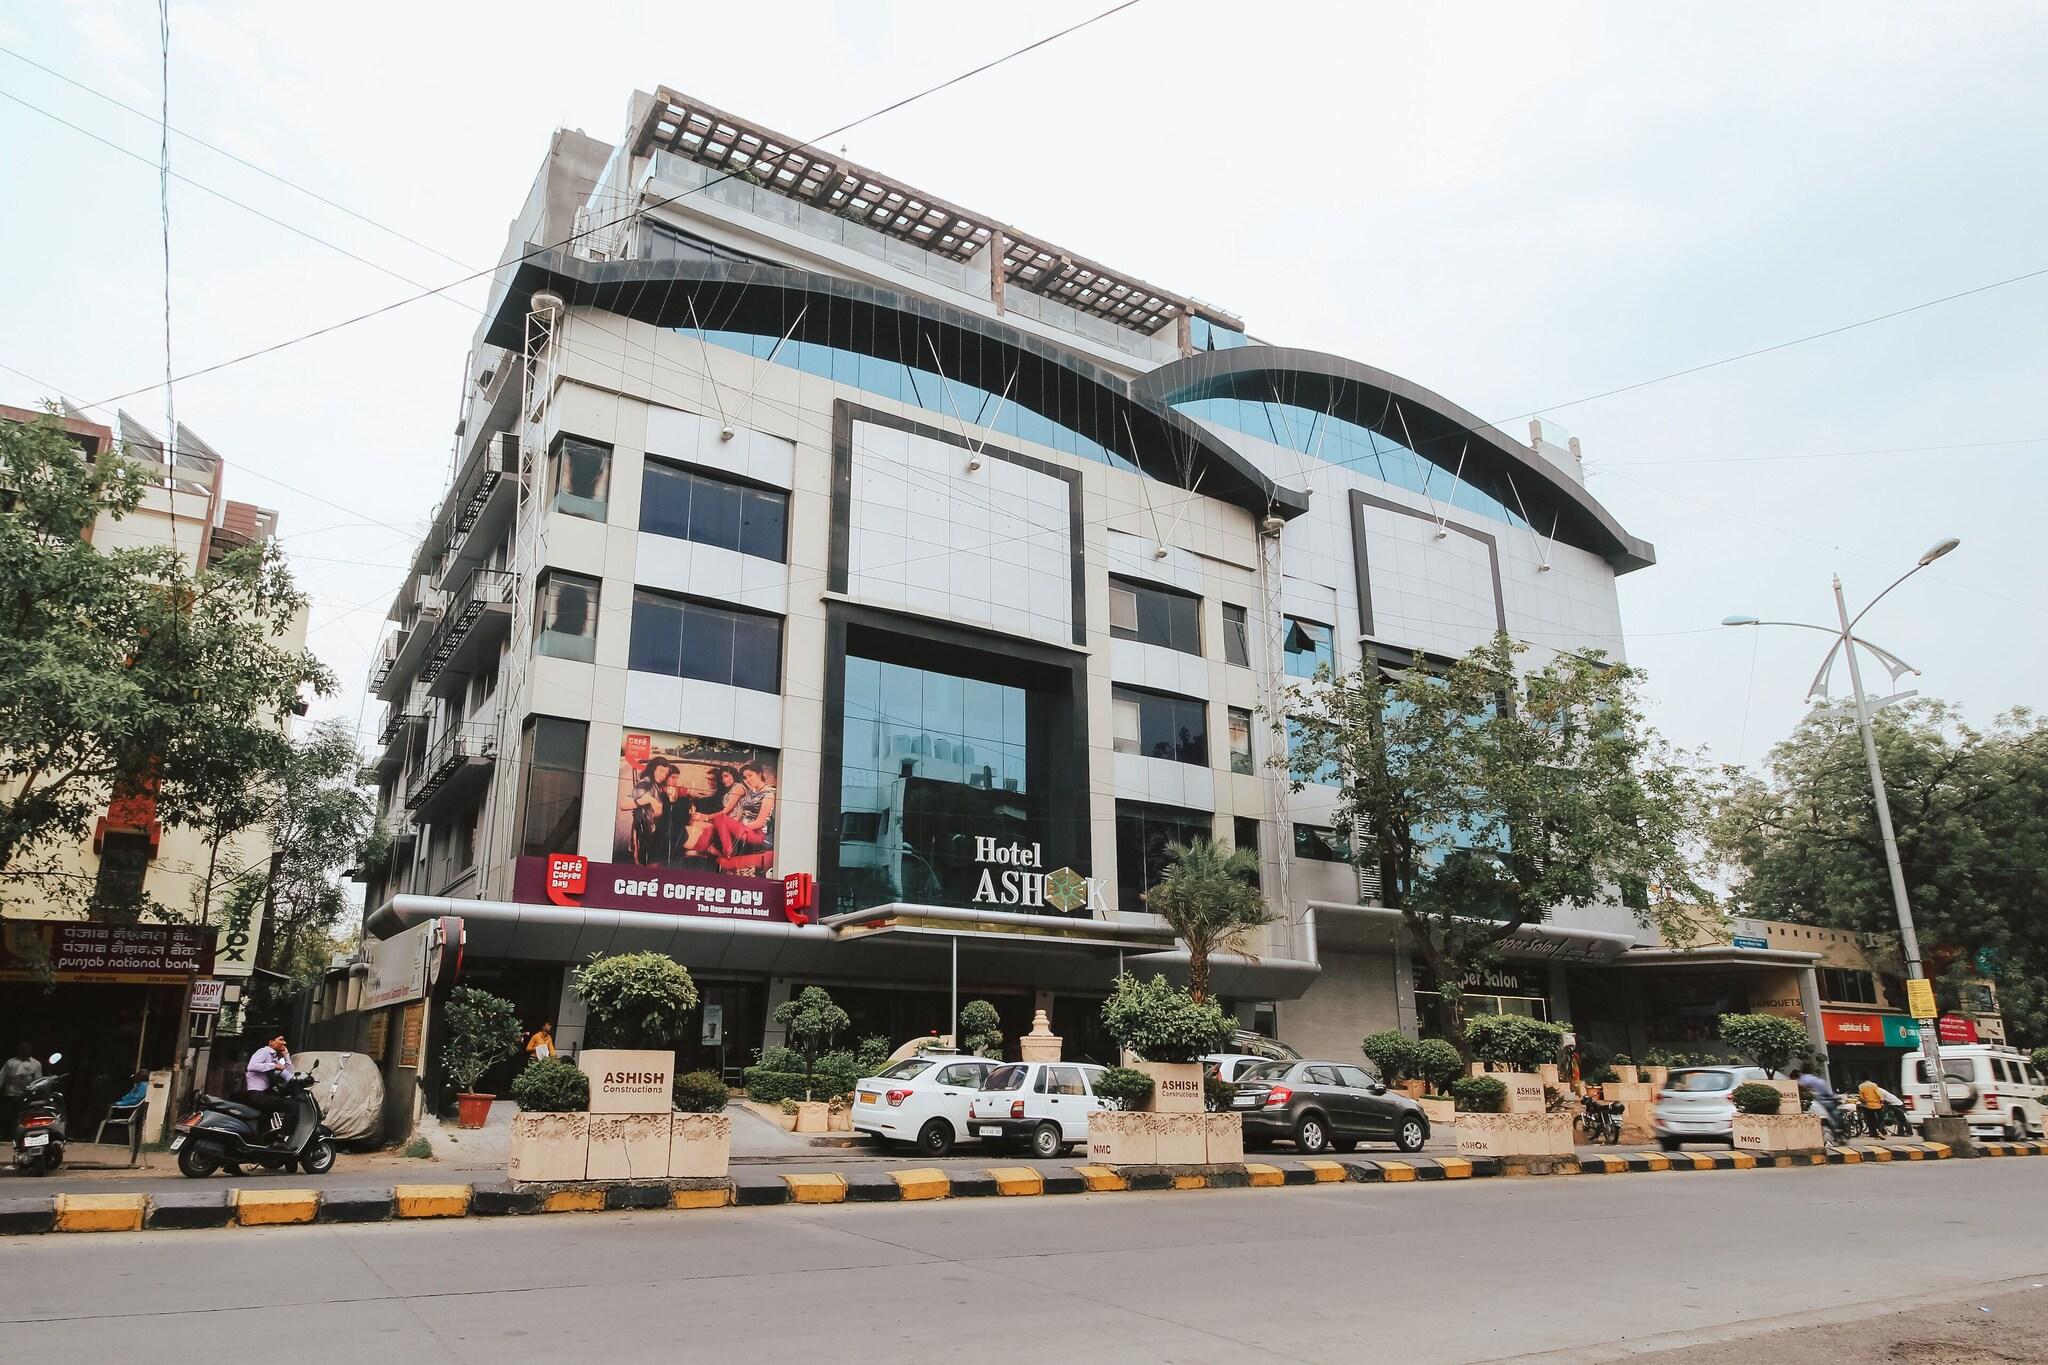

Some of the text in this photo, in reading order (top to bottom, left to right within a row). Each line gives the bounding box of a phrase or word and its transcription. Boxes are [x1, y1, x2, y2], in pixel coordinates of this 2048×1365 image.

[974, 835, 1042, 868] Hotel
[553, 860, 582, 872] Café
[552, 871, 582, 880] Coffee
[551, 879, 568, 889] Day
[697, 903, 710, 912] The
[733, 906, 753, 916] Ashok
[752, 907, 770, 917] Hotel
[63, 925, 110, 940] पंजाब
[62, 940, 202, 956] पंजाब नैशनल बैंक
[1526, 939, 1559, 953] Salon
[58, 957, 105, 970] punjab
[107, 957, 161, 969] national
[1484, 968, 1518, 989] Salon
[603, 1072, 665, 1085] ASHISH
[603, 1085, 663, 1094] Constructions
[1161, 1080, 1199, 1091] ASHISH
[1161, 1090, 1199, 1098] Constructions
[1516, 1087, 1541, 1096] ASHISH
[1740, 1135, 1761, 1144] NMC
[1093, 1144, 1112, 1154] NMC
[1460, 1141, 1489, 1150] ASHOK
